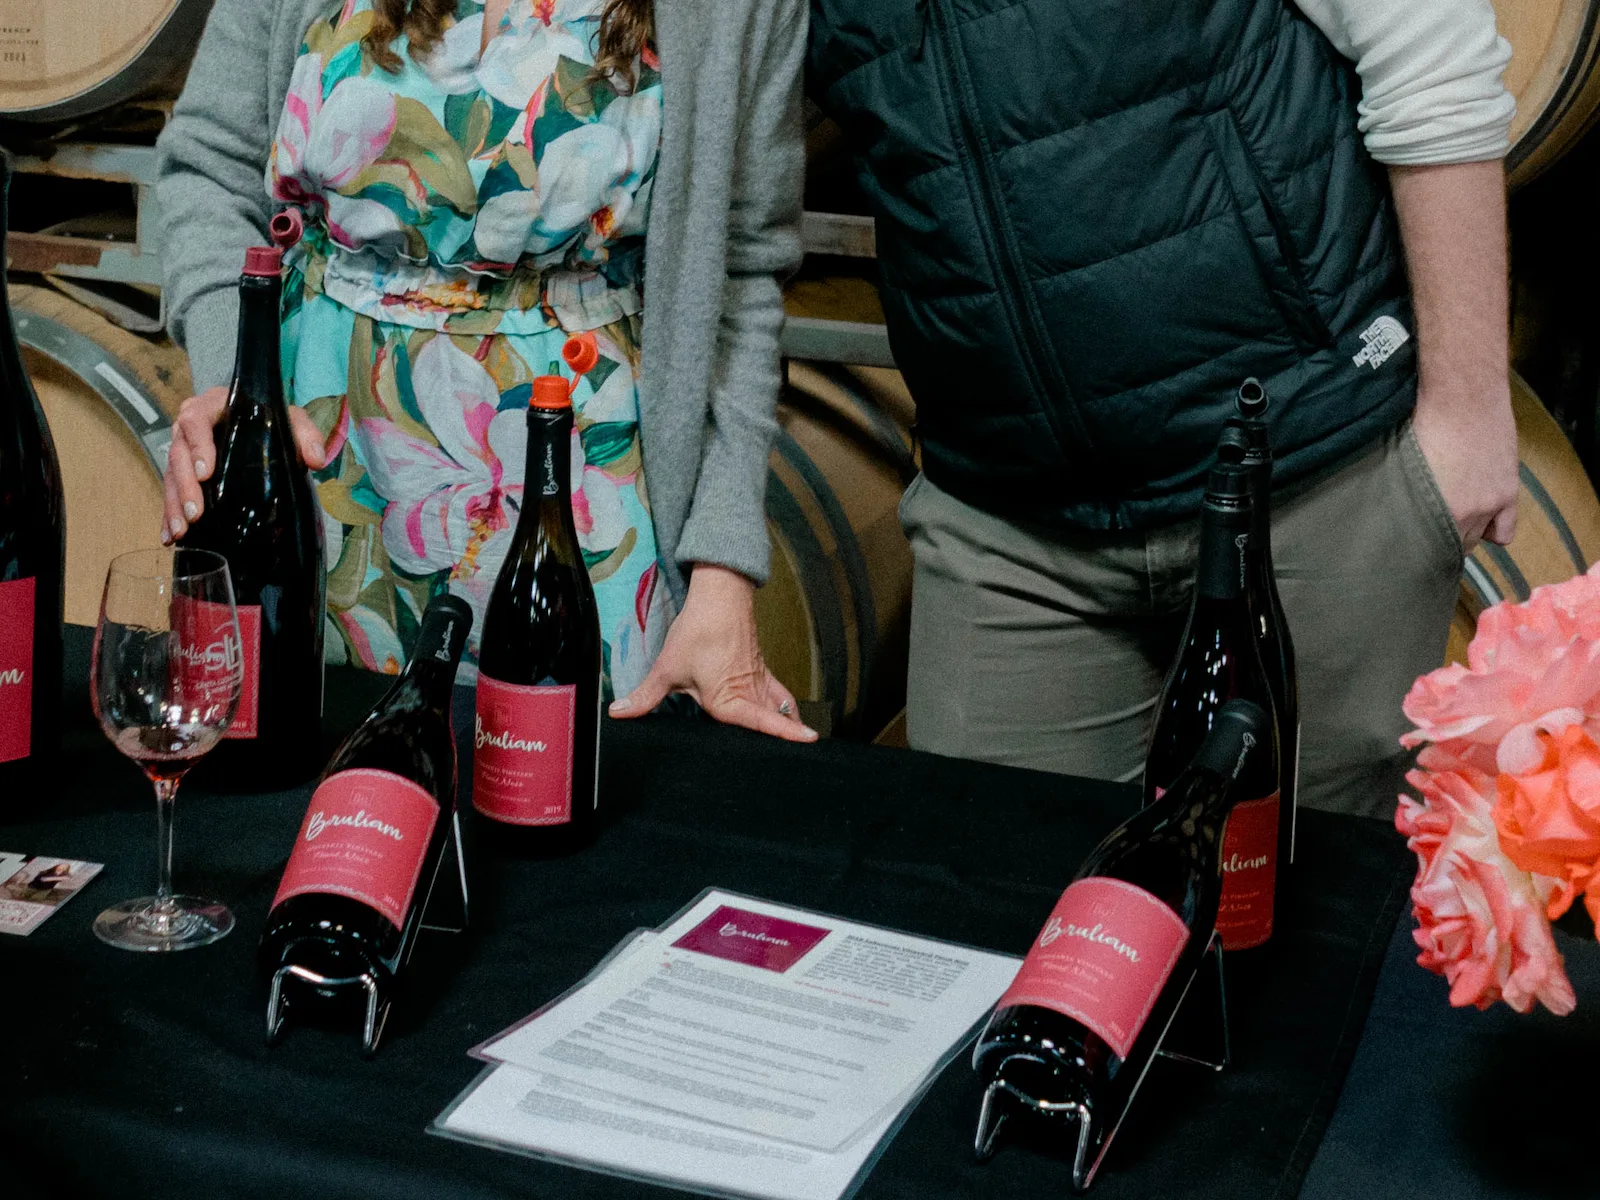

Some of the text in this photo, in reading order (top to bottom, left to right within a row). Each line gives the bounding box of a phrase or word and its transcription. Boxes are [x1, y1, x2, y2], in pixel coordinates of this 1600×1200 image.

[1358, 321, 1381, 345] THE
[1352, 334, 1390, 368] NORTH
[1368, 340, 1397, 370] FACE
[475, 711, 547, 753] Bruliam
[305, 809, 403, 842] Bruliam
[1039, 916, 1142, 964] Bruliam
